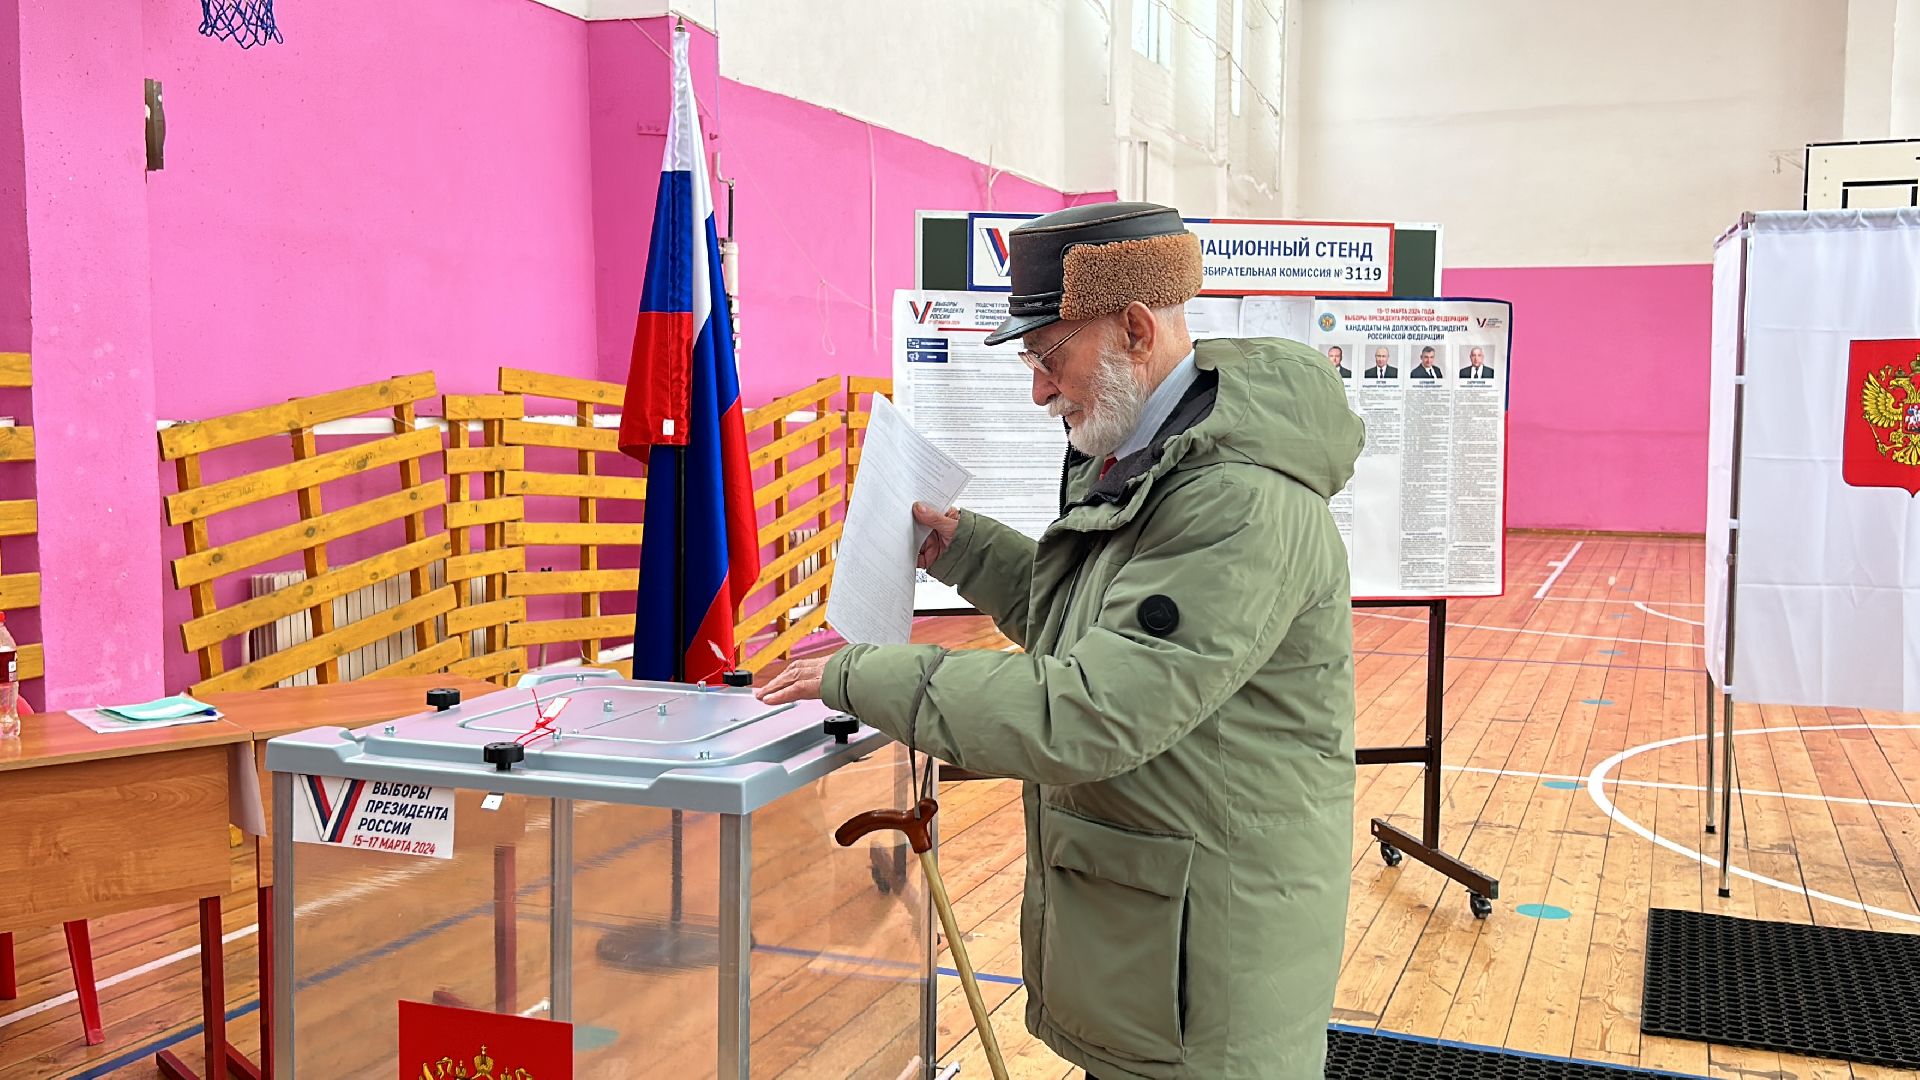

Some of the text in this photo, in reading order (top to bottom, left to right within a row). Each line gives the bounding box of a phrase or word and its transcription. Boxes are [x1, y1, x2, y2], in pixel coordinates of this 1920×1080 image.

[1316, 241, 1373, 262] СТЕНД
[1279, 267, 1331, 278] КОМИССИЯ
[1345, 266, 1381, 281] 3119
[1345, 324, 1382, 332] КАНДИДАТЫ
[1391, 325, 1428, 333] ДОЛЖНОСТЬ
[1429, 325, 1468, 333] ПРЕЗИДЕНТА
[1367, 332, 1445, 341] РОССИЙСКОЙ ФЕДЕРАЦИИ
[372, 782, 432, 800] ВЫБОРЫ
[364, 800, 449, 820] ПРЕЗИДЕНТА
[357, 817, 412, 836] РОССИИ
[380, 838, 411, 853] МАРТА
[412, 841, 436, 856] 2024
